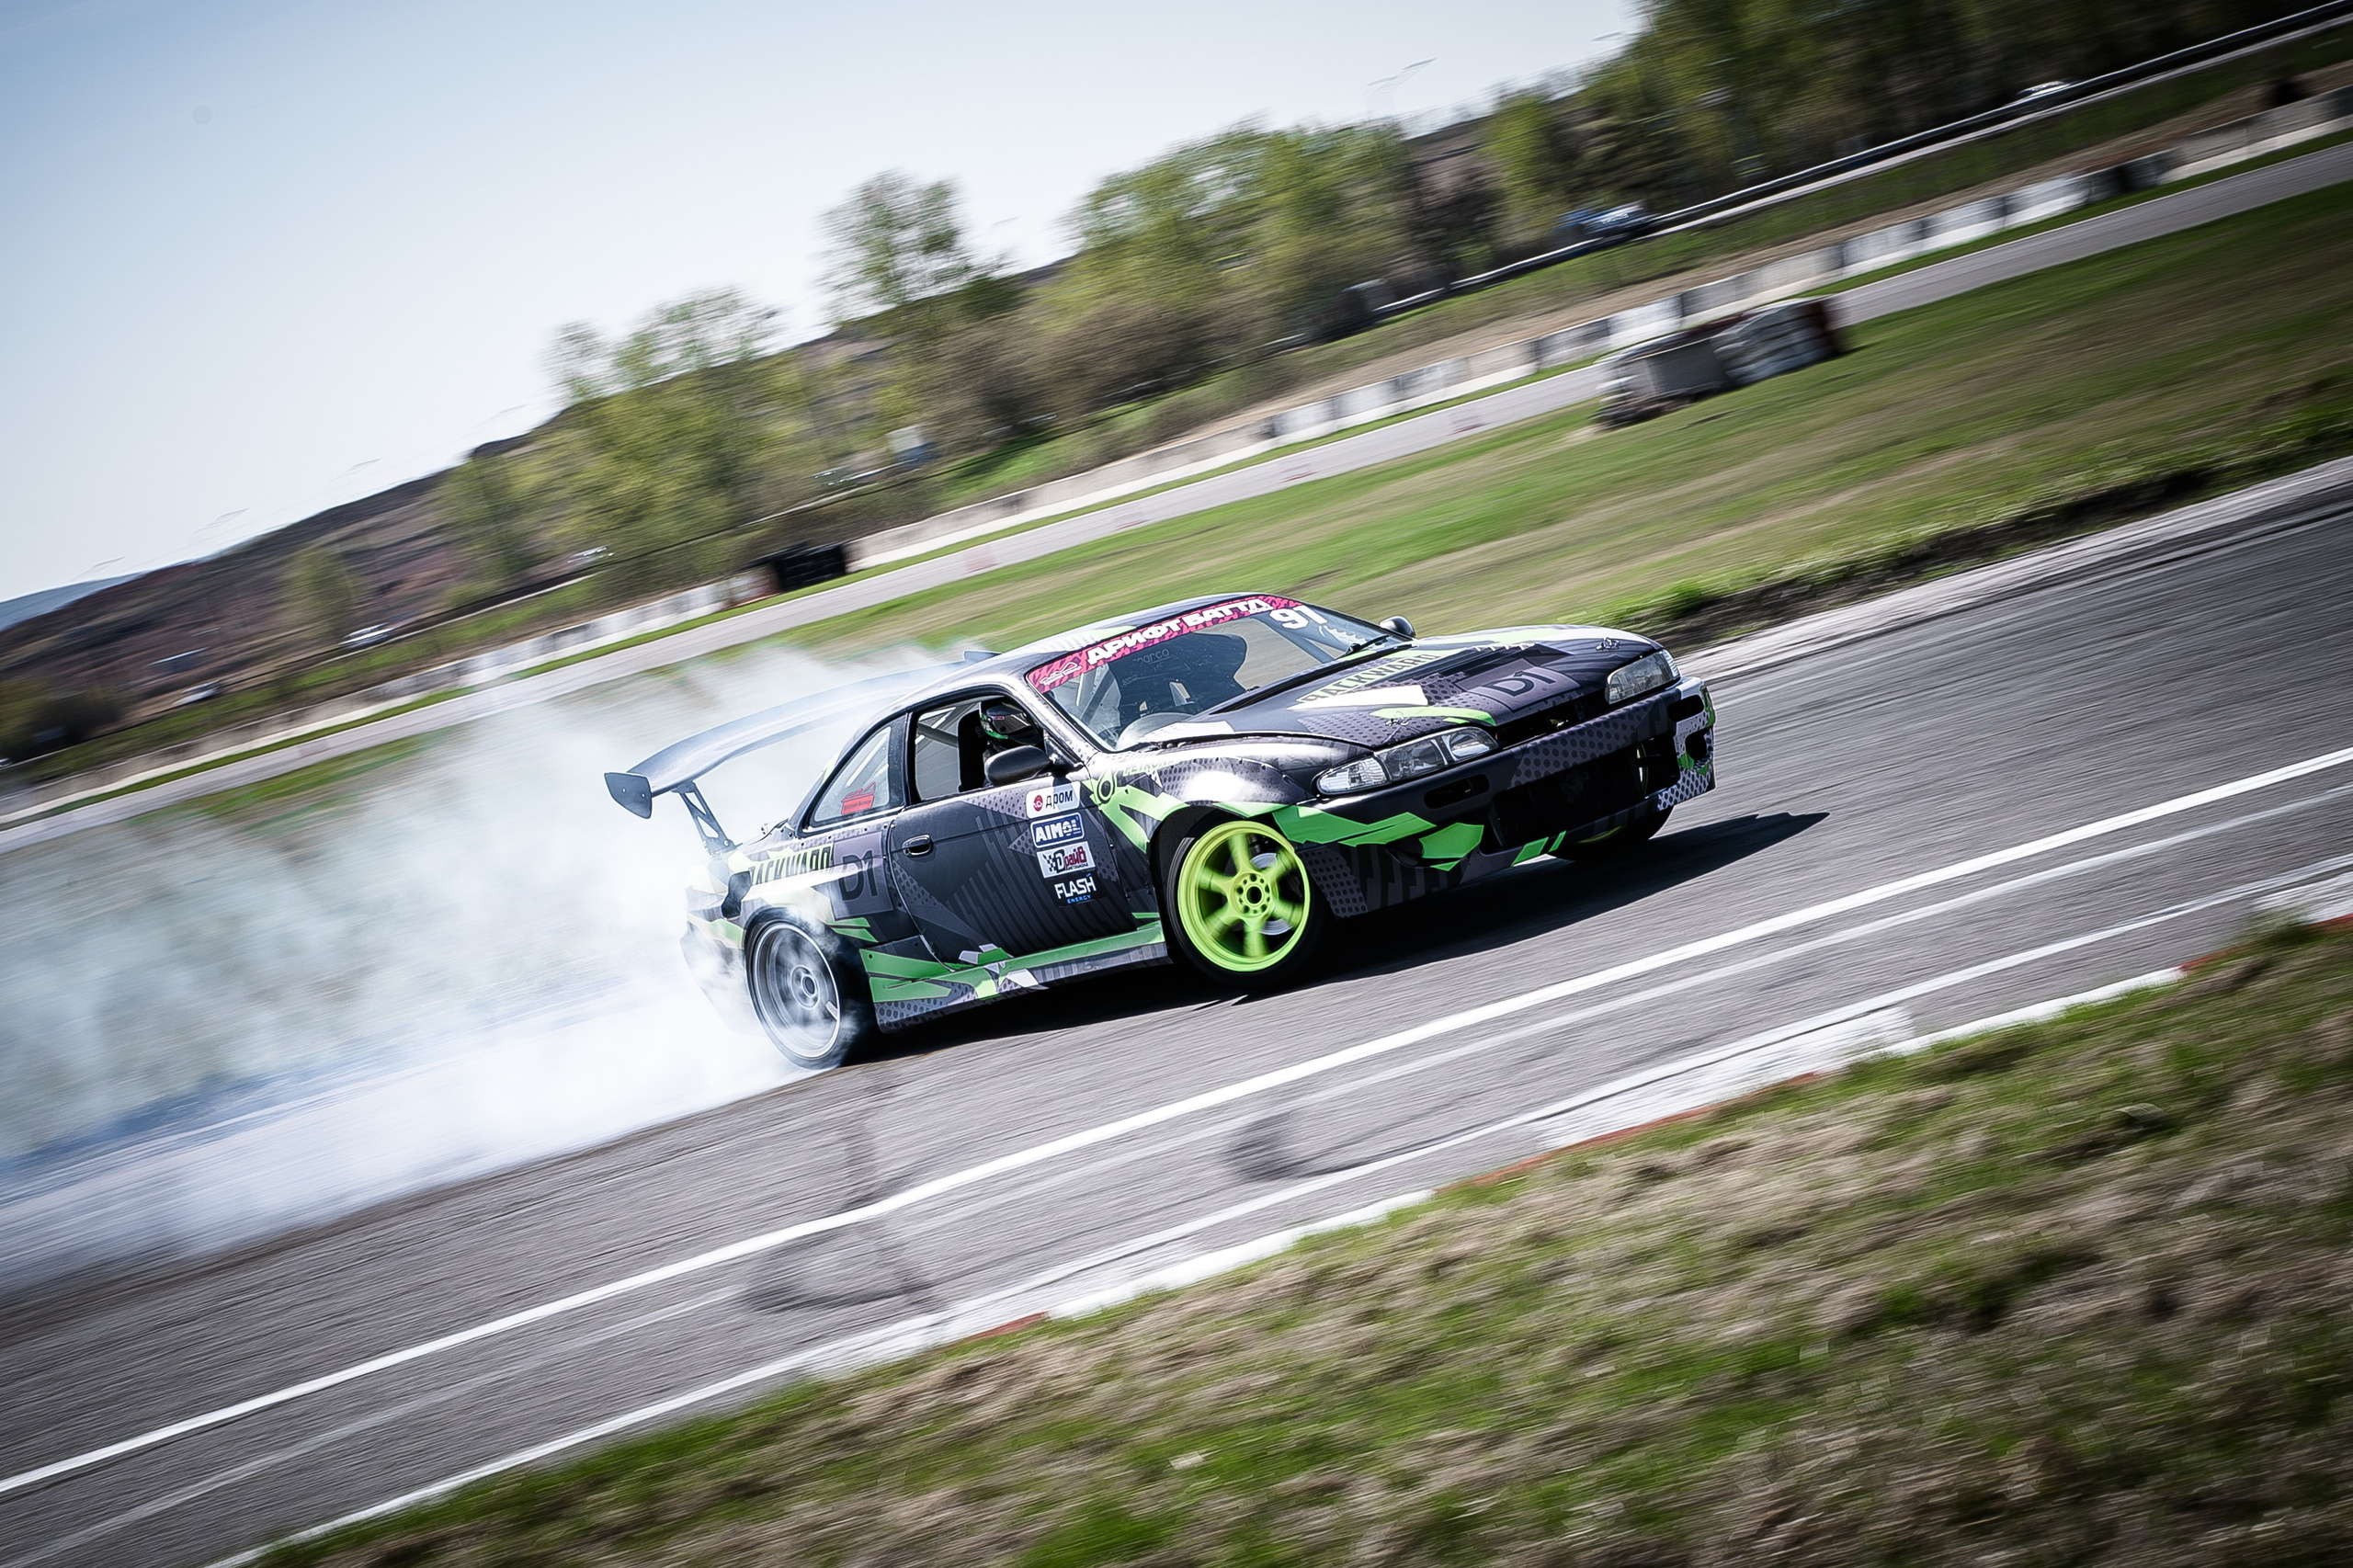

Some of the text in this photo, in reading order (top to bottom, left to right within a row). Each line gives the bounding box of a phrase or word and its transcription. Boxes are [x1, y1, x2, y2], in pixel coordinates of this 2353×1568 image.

[1269, 605, 1328, 630] 91
[1035, 819, 1081, 843] AIMOL
[837, 849, 879, 901] D1
[1054, 876, 1097, 899] FLASH
[1066, 894, 1091, 903] ENERGY
